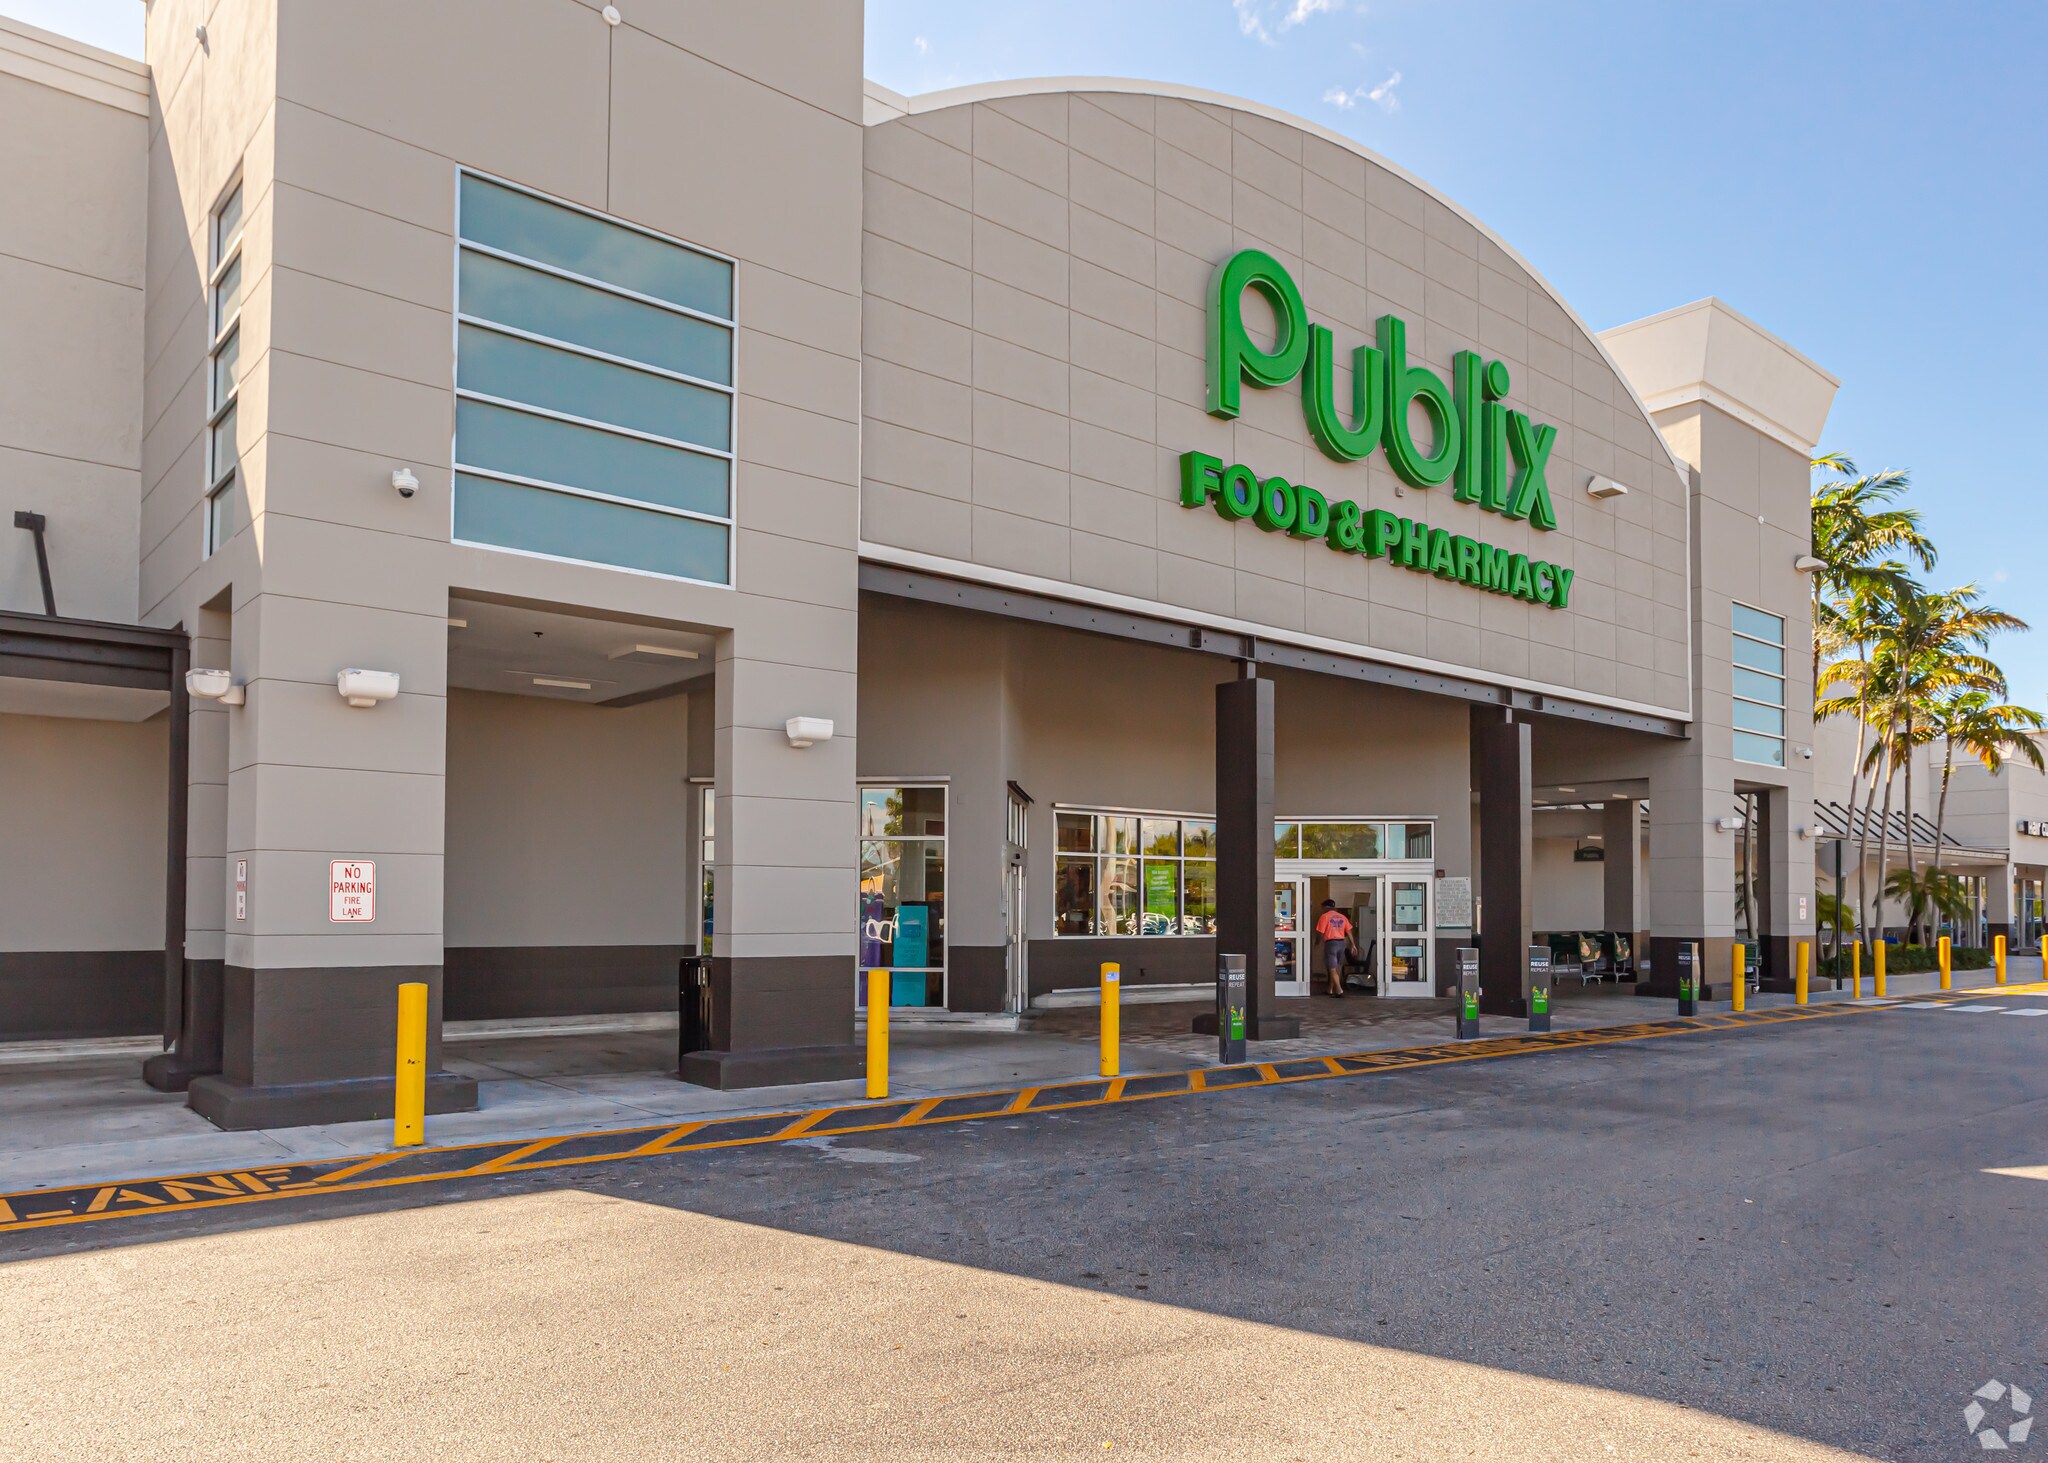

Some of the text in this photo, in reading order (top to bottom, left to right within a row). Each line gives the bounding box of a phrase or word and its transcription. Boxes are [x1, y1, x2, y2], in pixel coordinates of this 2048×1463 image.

[1206, 248, 1558, 531] Publix
[1180, 450, 1575, 610] FOOD & PHARMACY
[344, 867, 361, 879] NO
[333, 881, 372, 894] PARKING
[344, 896, 361, 905] FIRE
[342, 907, 362, 916] LANE
[1228, 973, 1246, 981] REUSE
[0, 1168, 319, 1222] LANE
